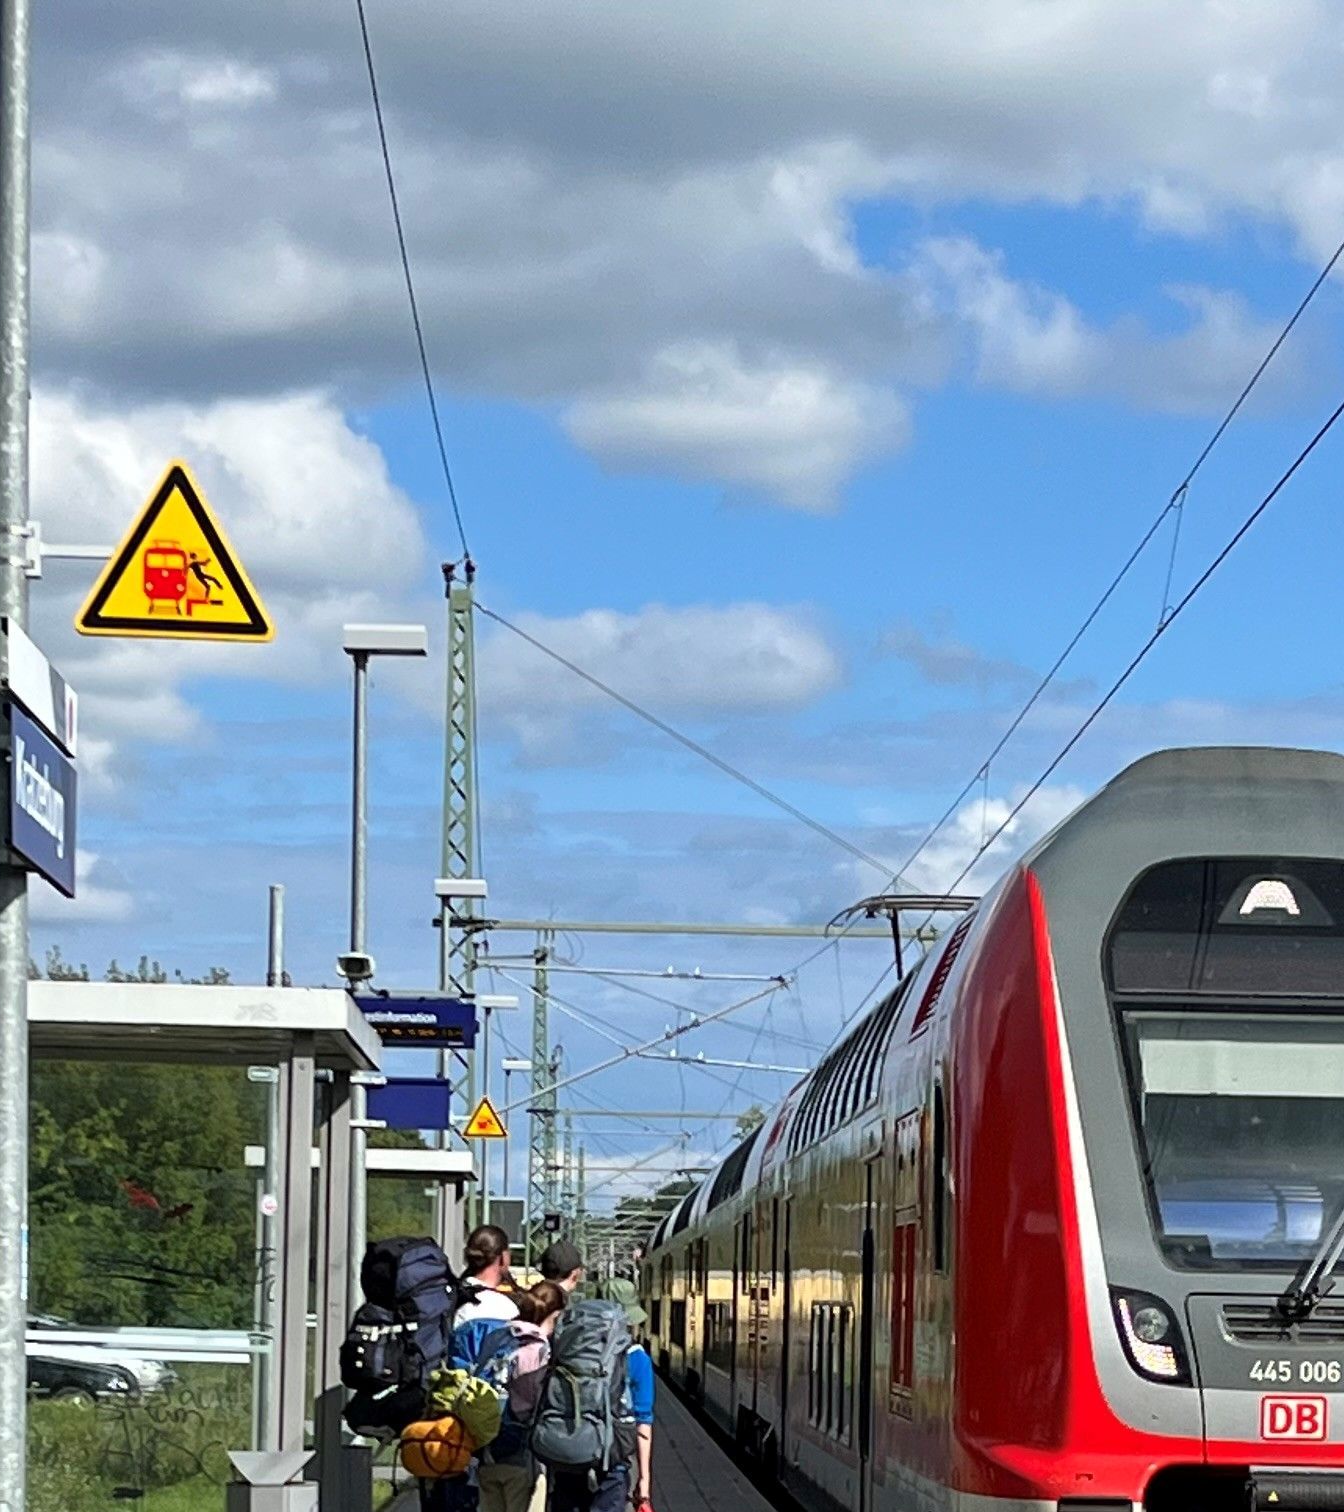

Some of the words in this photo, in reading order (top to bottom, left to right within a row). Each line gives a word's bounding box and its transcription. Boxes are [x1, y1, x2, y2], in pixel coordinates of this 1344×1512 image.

[1250, 1360, 1291, 1381] 445
[1300, 1361, 1341, 1382] 006
[1269, 1403, 1319, 1434] DB
